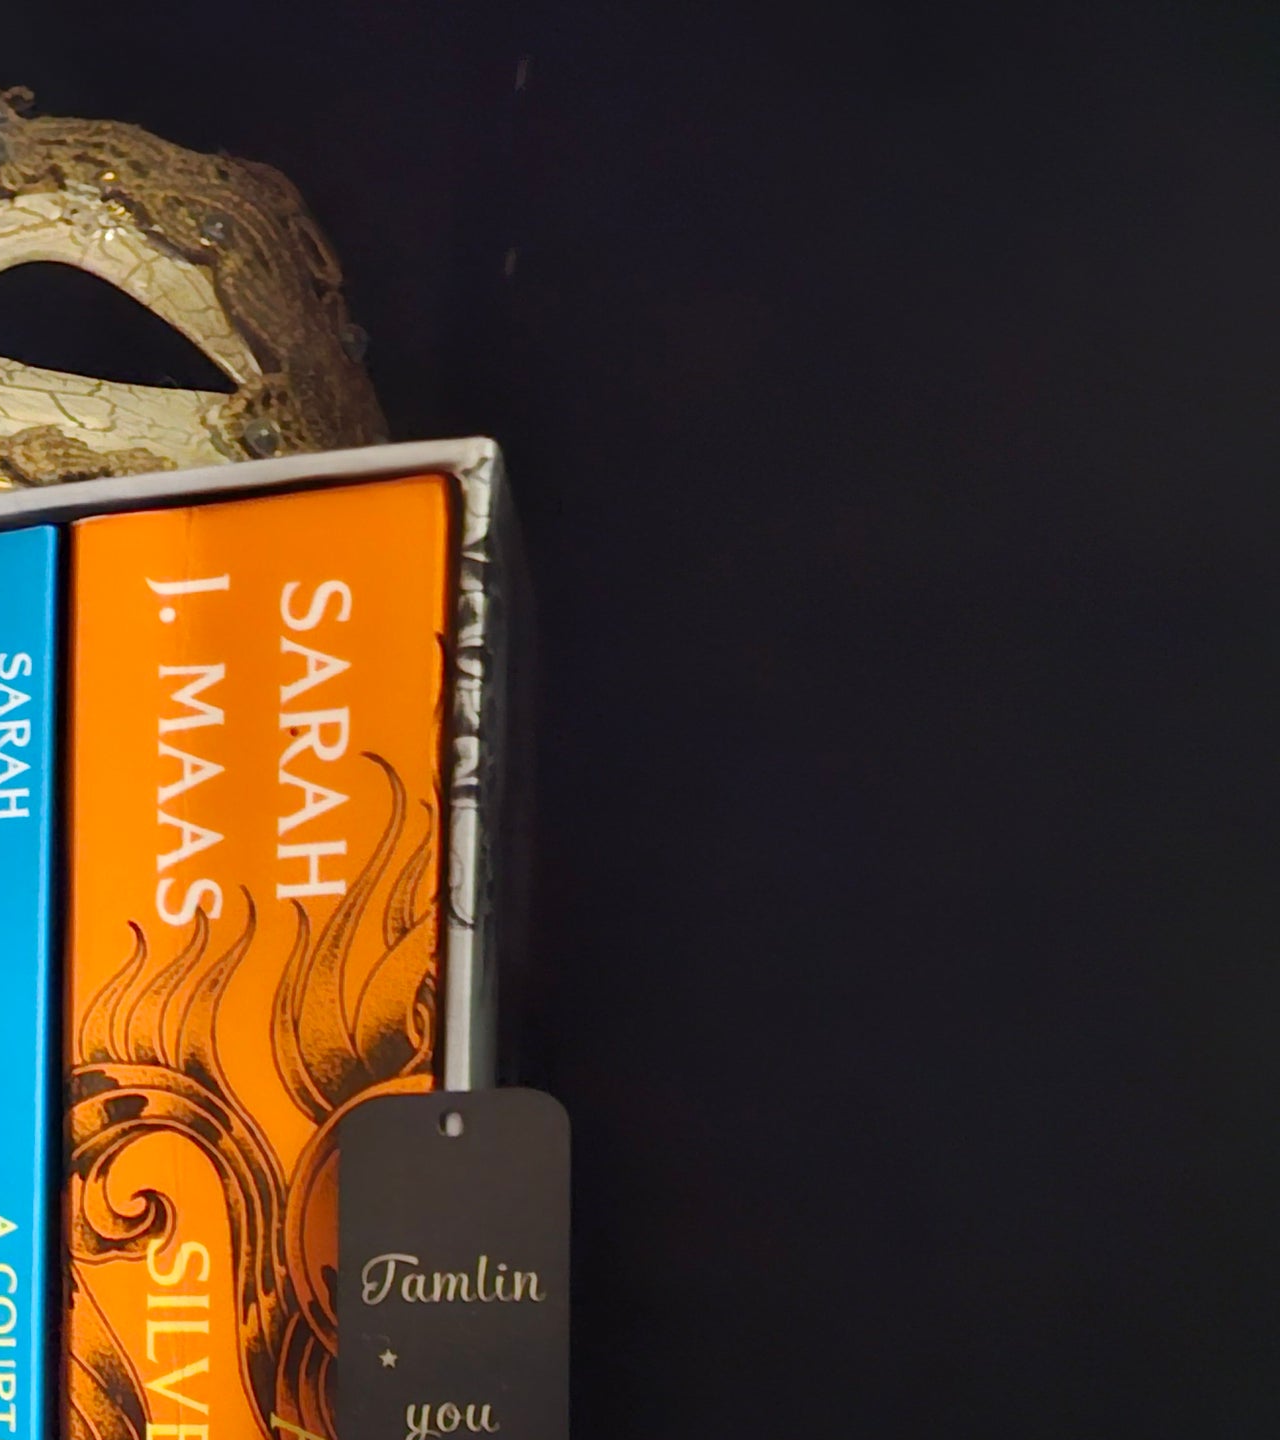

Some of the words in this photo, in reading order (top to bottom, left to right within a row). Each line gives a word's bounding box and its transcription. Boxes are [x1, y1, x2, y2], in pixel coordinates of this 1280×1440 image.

[145, 573, 230, 624] J.
[155, 662, 226, 927] MAAS
[275, 579, 352, 900] SARAH
[360, 1252, 547, 1307] Tamlin
